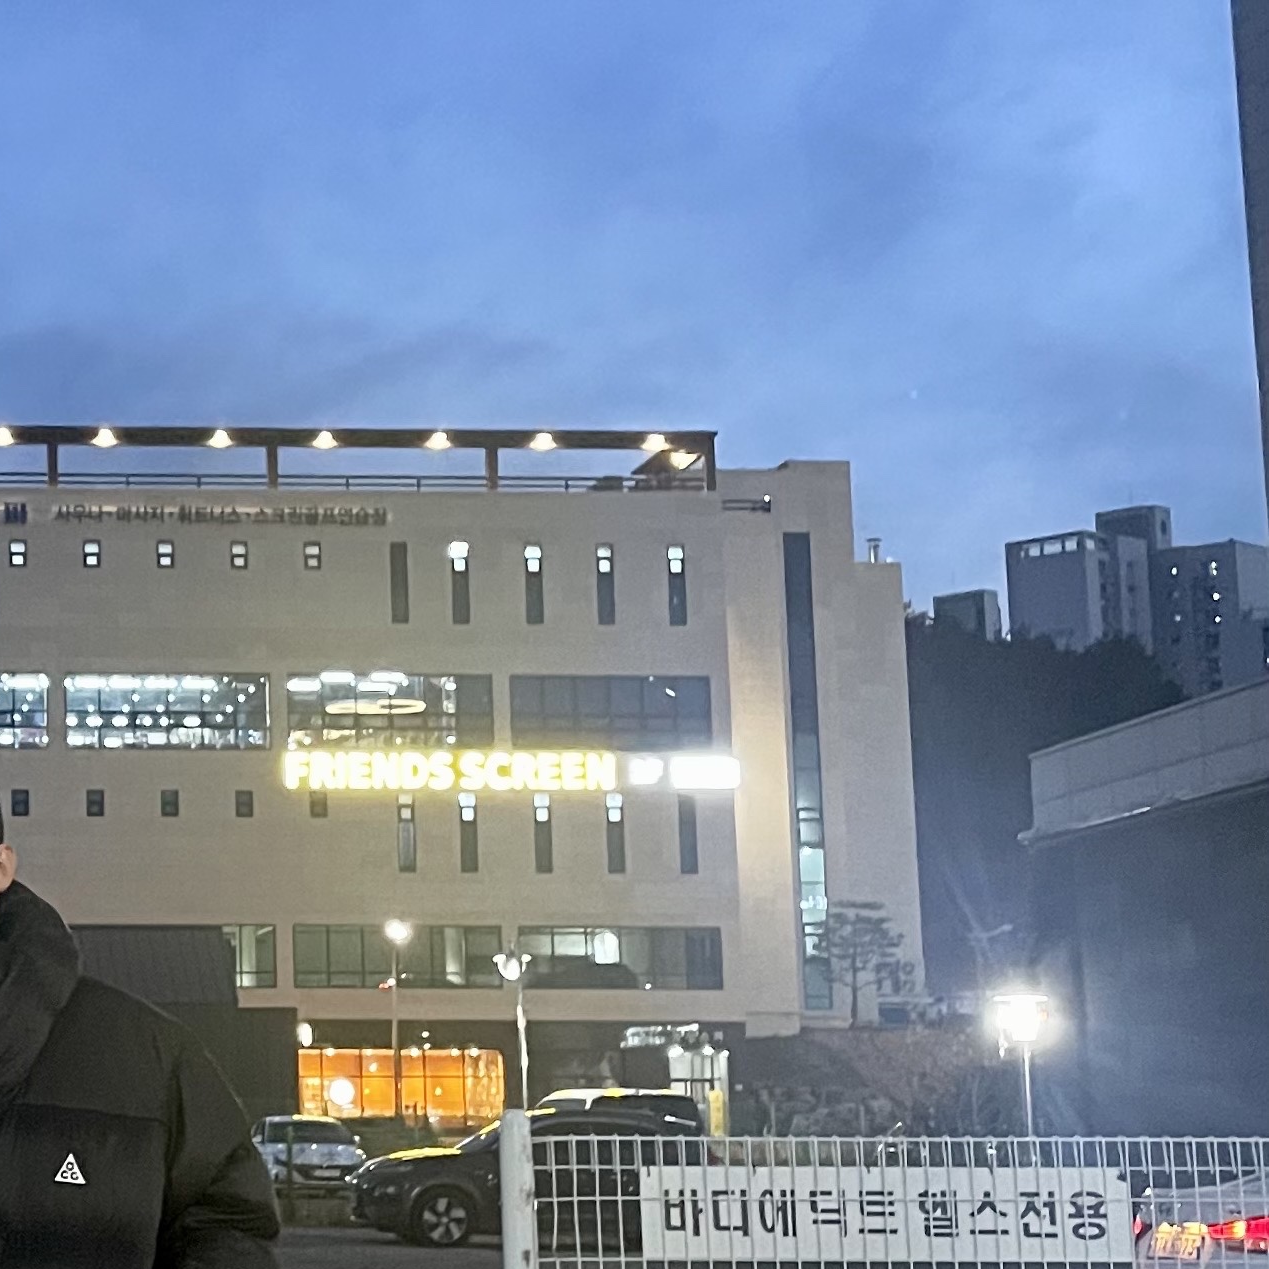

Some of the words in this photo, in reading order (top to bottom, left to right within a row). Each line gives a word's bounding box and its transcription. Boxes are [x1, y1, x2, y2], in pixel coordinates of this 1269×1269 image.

[284, 751, 455, 791] FRIENDS
[458, 751, 617, 791] SCREEN
[917, 1188, 1108, 1241] 헬스전용
